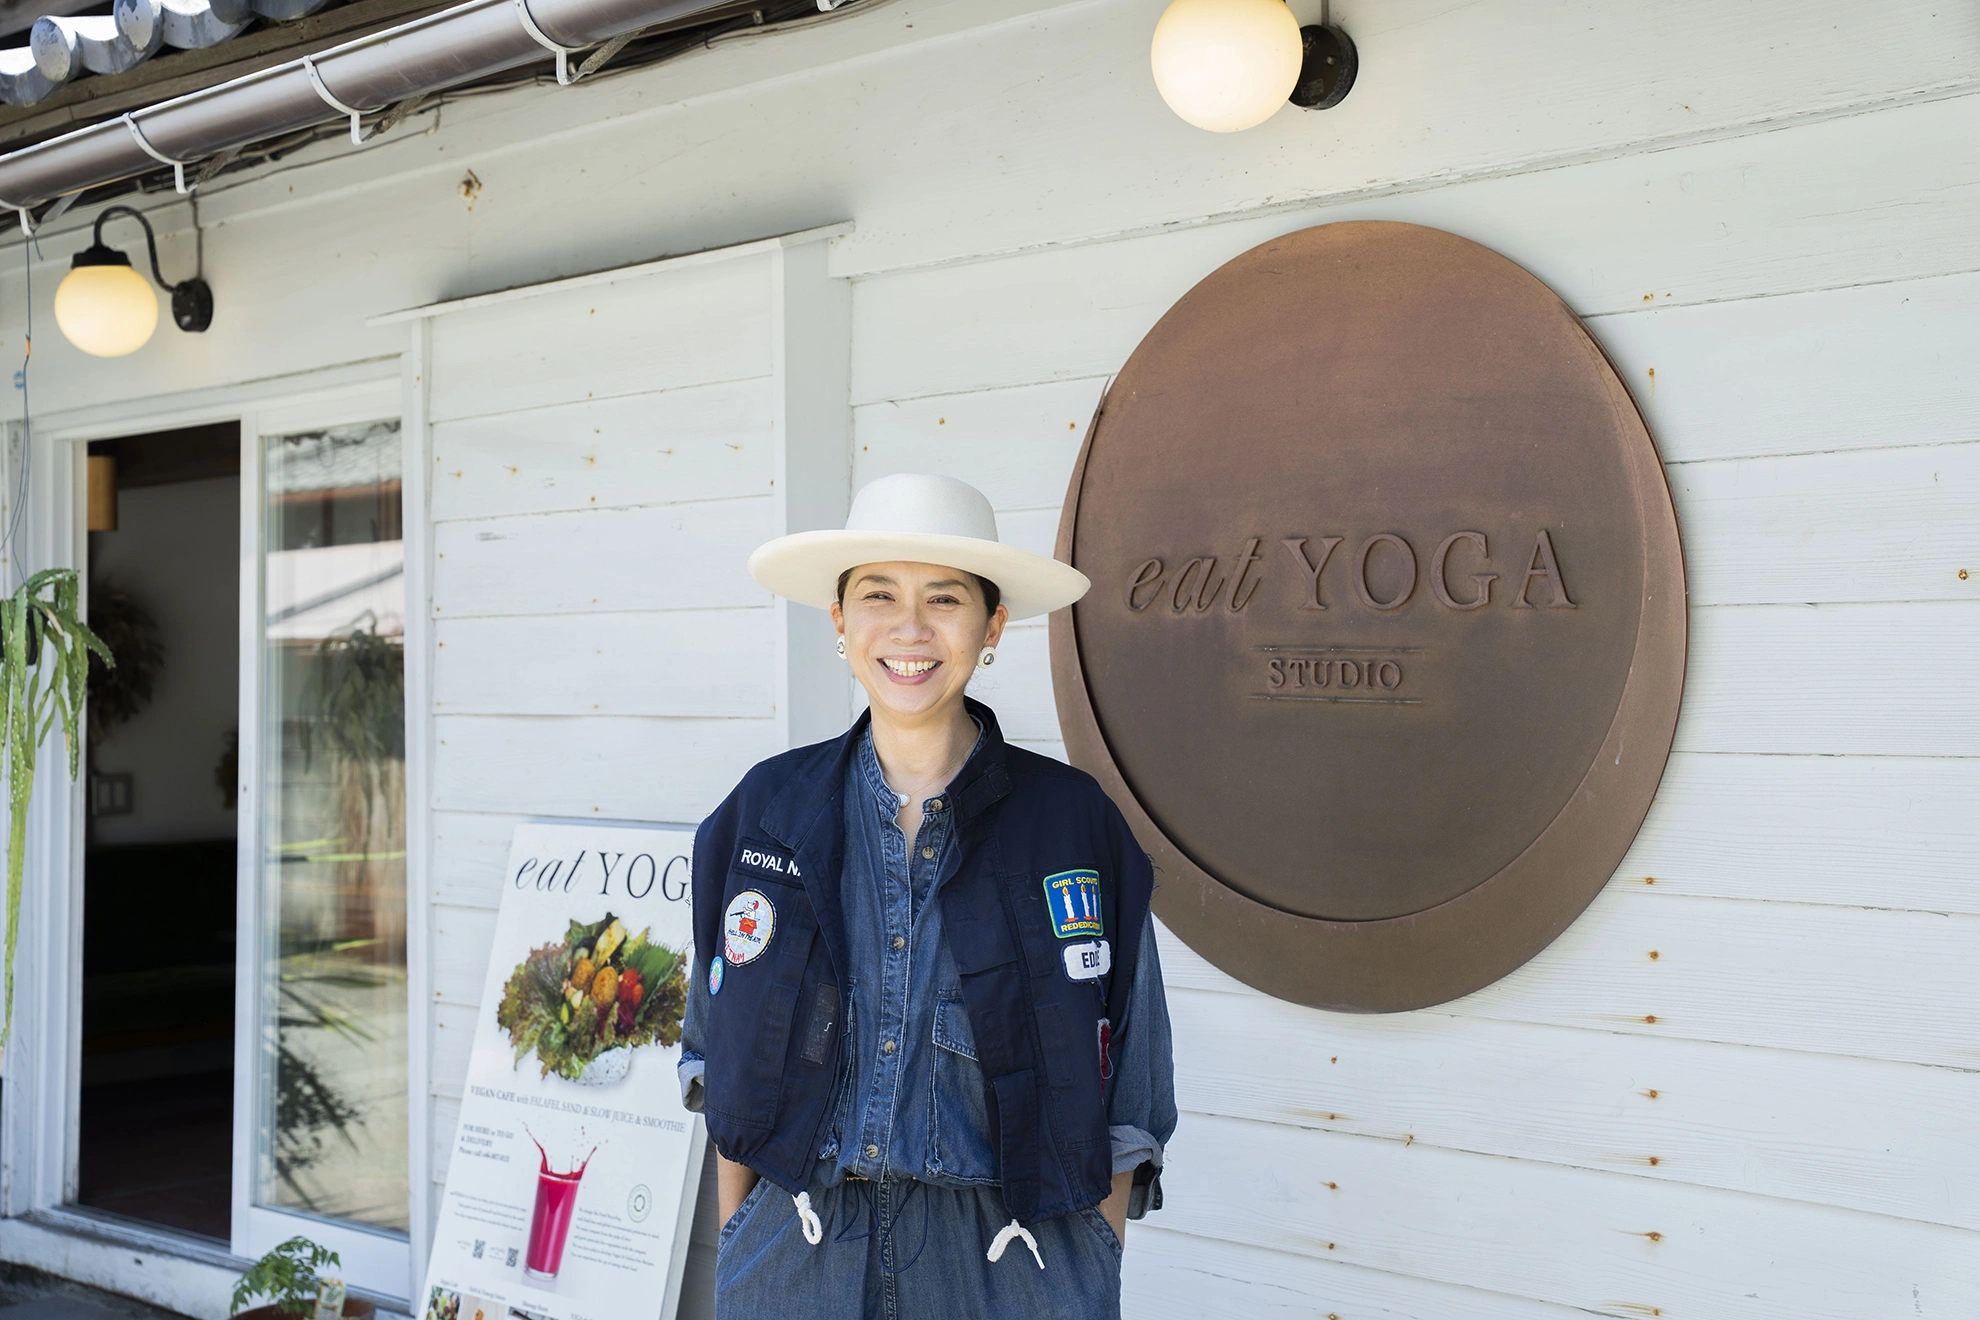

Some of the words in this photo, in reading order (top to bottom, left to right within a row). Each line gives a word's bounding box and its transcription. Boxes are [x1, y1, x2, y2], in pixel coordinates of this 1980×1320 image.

[1122, 537, 1263, 614] eat
[1281, 528, 1578, 611] YOGA
[1266, 657, 1404, 691] STUDIO
[515, 850, 587, 894] eat
[598, 851, 690, 902] YOG
[741, 849, 783, 872] ROYAL
[1052, 878, 1074, 889] GIRL
[470, 1085, 495, 1098] VEGAN
[496, 1090, 516, 1102] CAFE
[529, 1096, 560, 1111] FALAFEL
[561, 1103, 583, 1115] SAND
[611, 1110, 634, 1124] JUICE
[642, 1117, 686, 1134] SMOOTHIE
